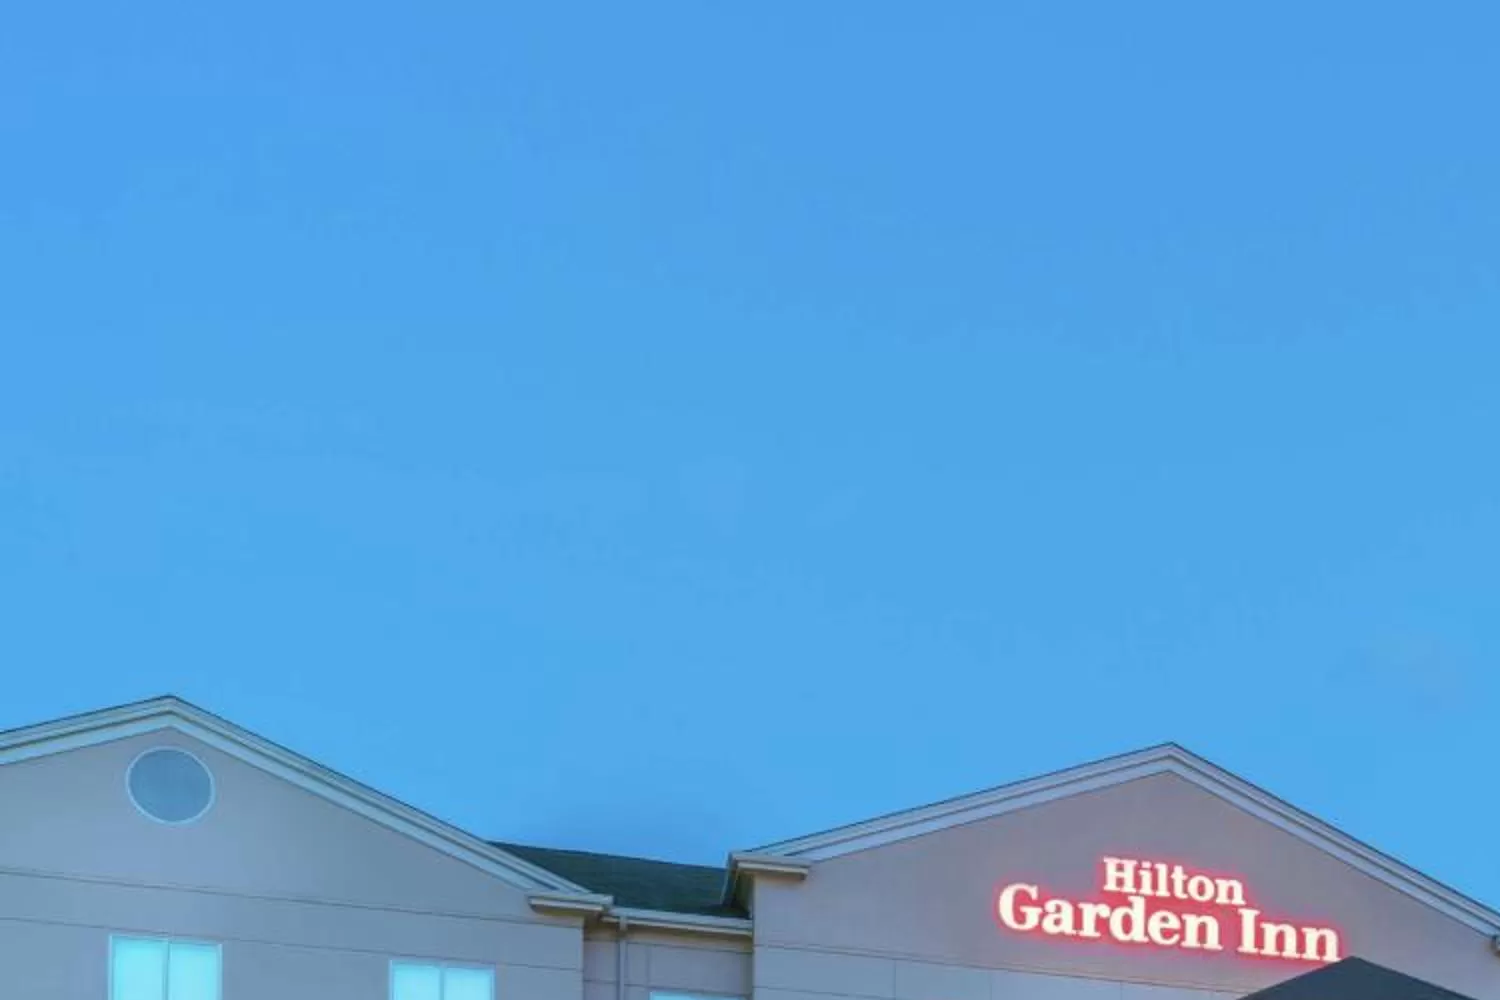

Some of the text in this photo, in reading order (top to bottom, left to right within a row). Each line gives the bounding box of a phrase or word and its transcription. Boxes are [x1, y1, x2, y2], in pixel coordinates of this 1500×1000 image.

[1103, 857, 1245, 905] Hilton
[999, 883, 1341, 963] Garden Inn
